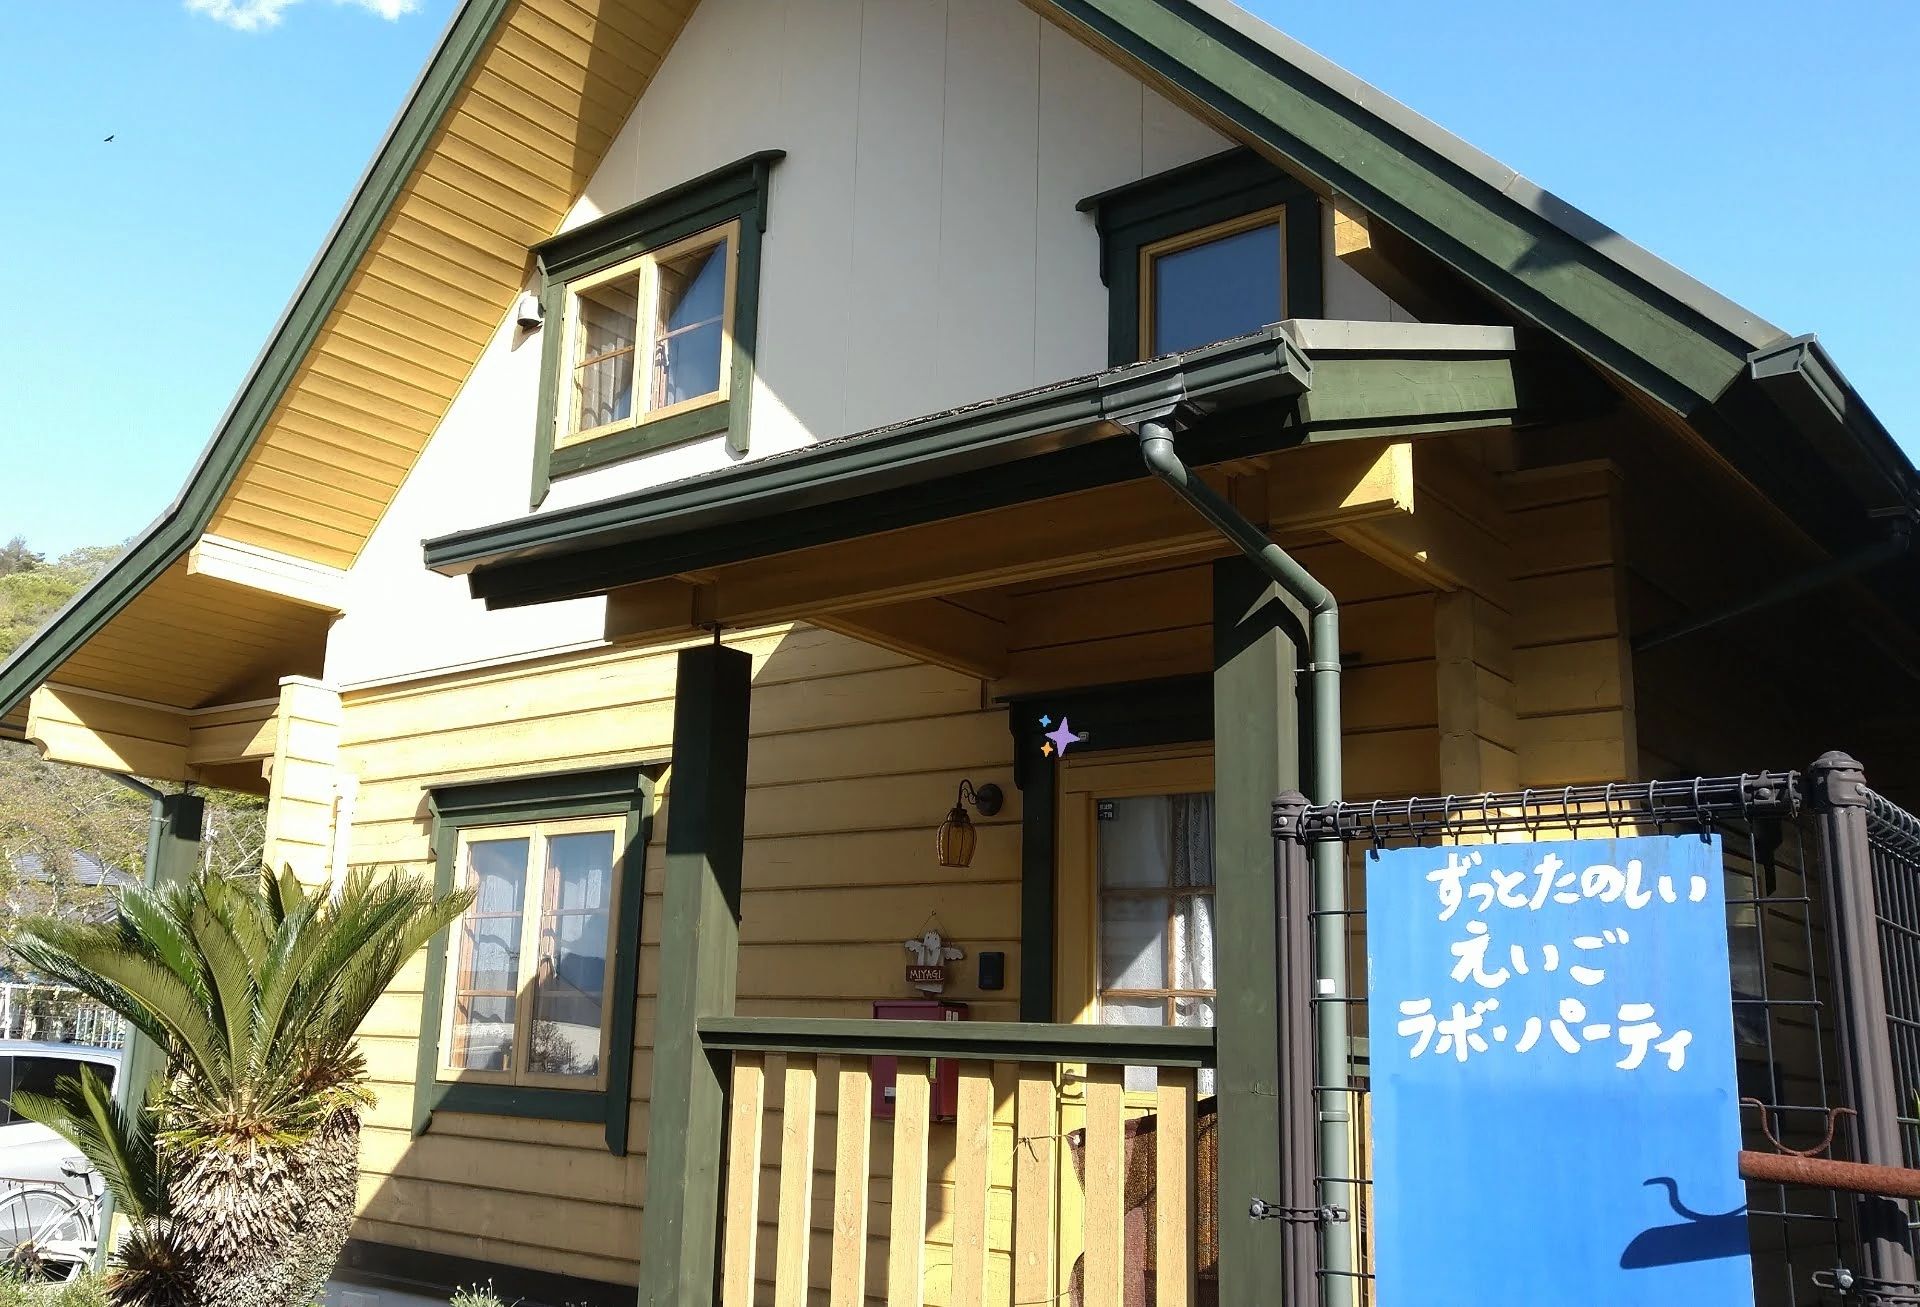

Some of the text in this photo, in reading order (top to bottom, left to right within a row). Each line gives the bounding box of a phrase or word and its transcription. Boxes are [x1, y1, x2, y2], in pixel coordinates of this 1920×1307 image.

[1425, 851, 1707, 921] ずっとたのしい
[909, 968, 942, 981] MIYAGI
[1450, 919, 1629, 989] えいご
[1397, 998, 1693, 1072] ラボ・パーティ
